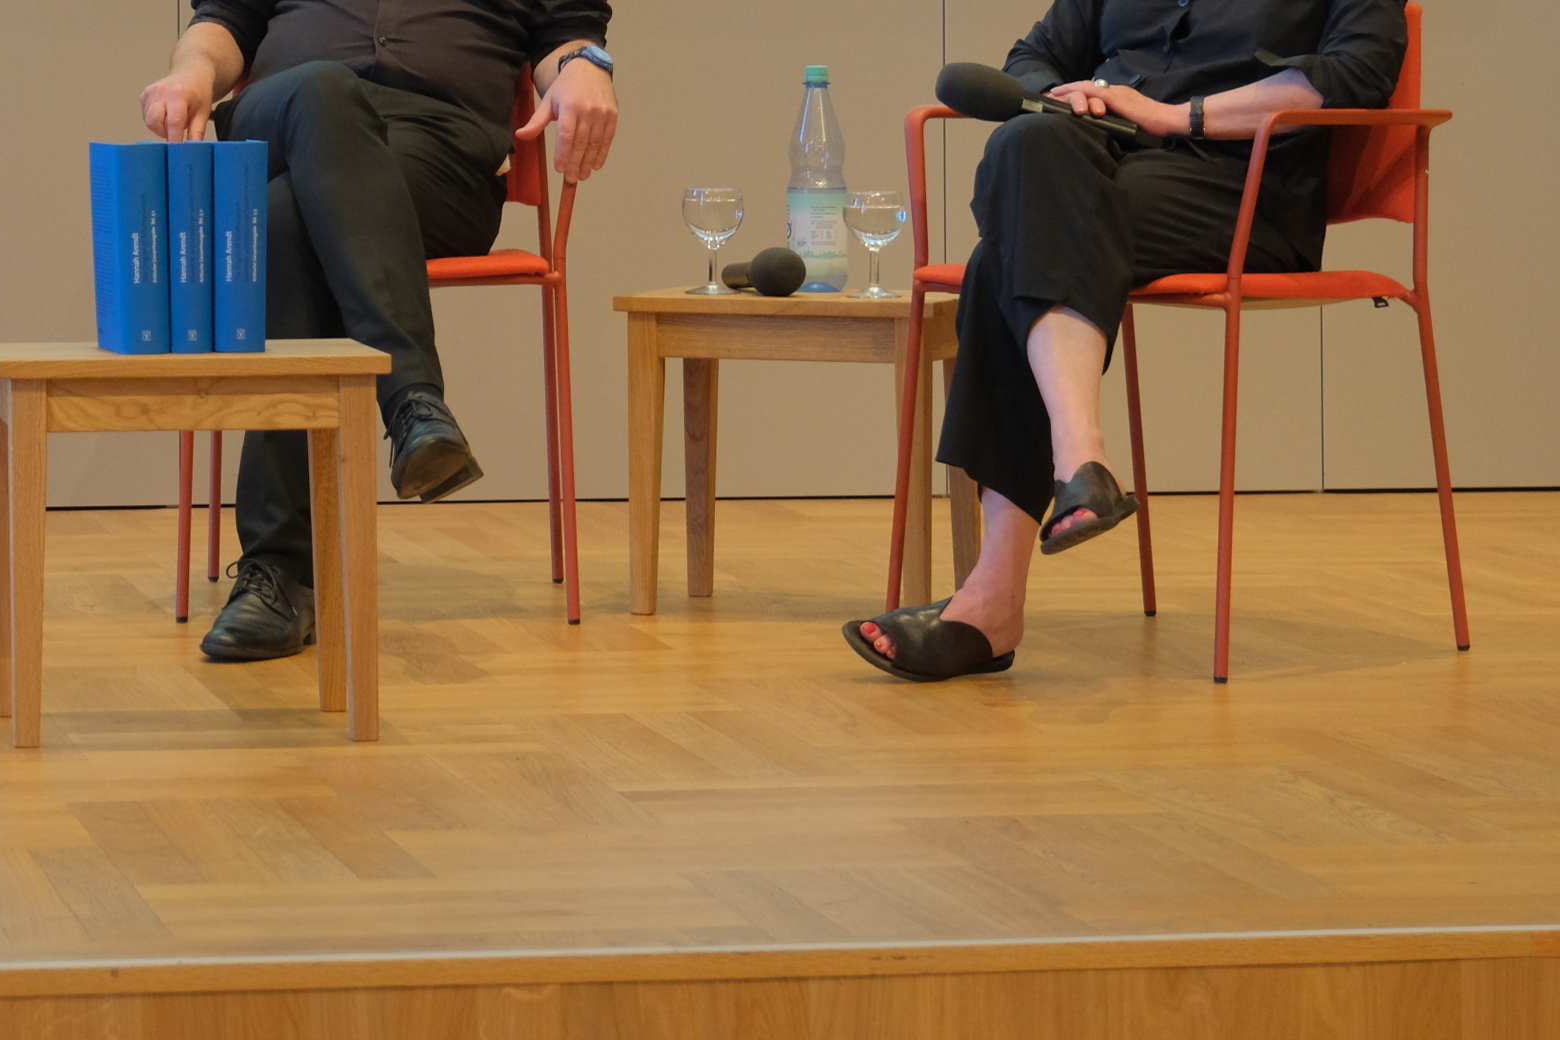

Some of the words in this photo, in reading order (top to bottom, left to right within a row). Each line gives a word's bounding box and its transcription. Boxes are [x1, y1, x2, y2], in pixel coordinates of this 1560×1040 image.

[131, 232, 139, 256] Arendt
[179, 231, 187, 255] Arendt
[132, 257, 140, 284] Hannah
[179, 256, 187, 283] Hannah
[225, 255, 233, 282] Hannah
